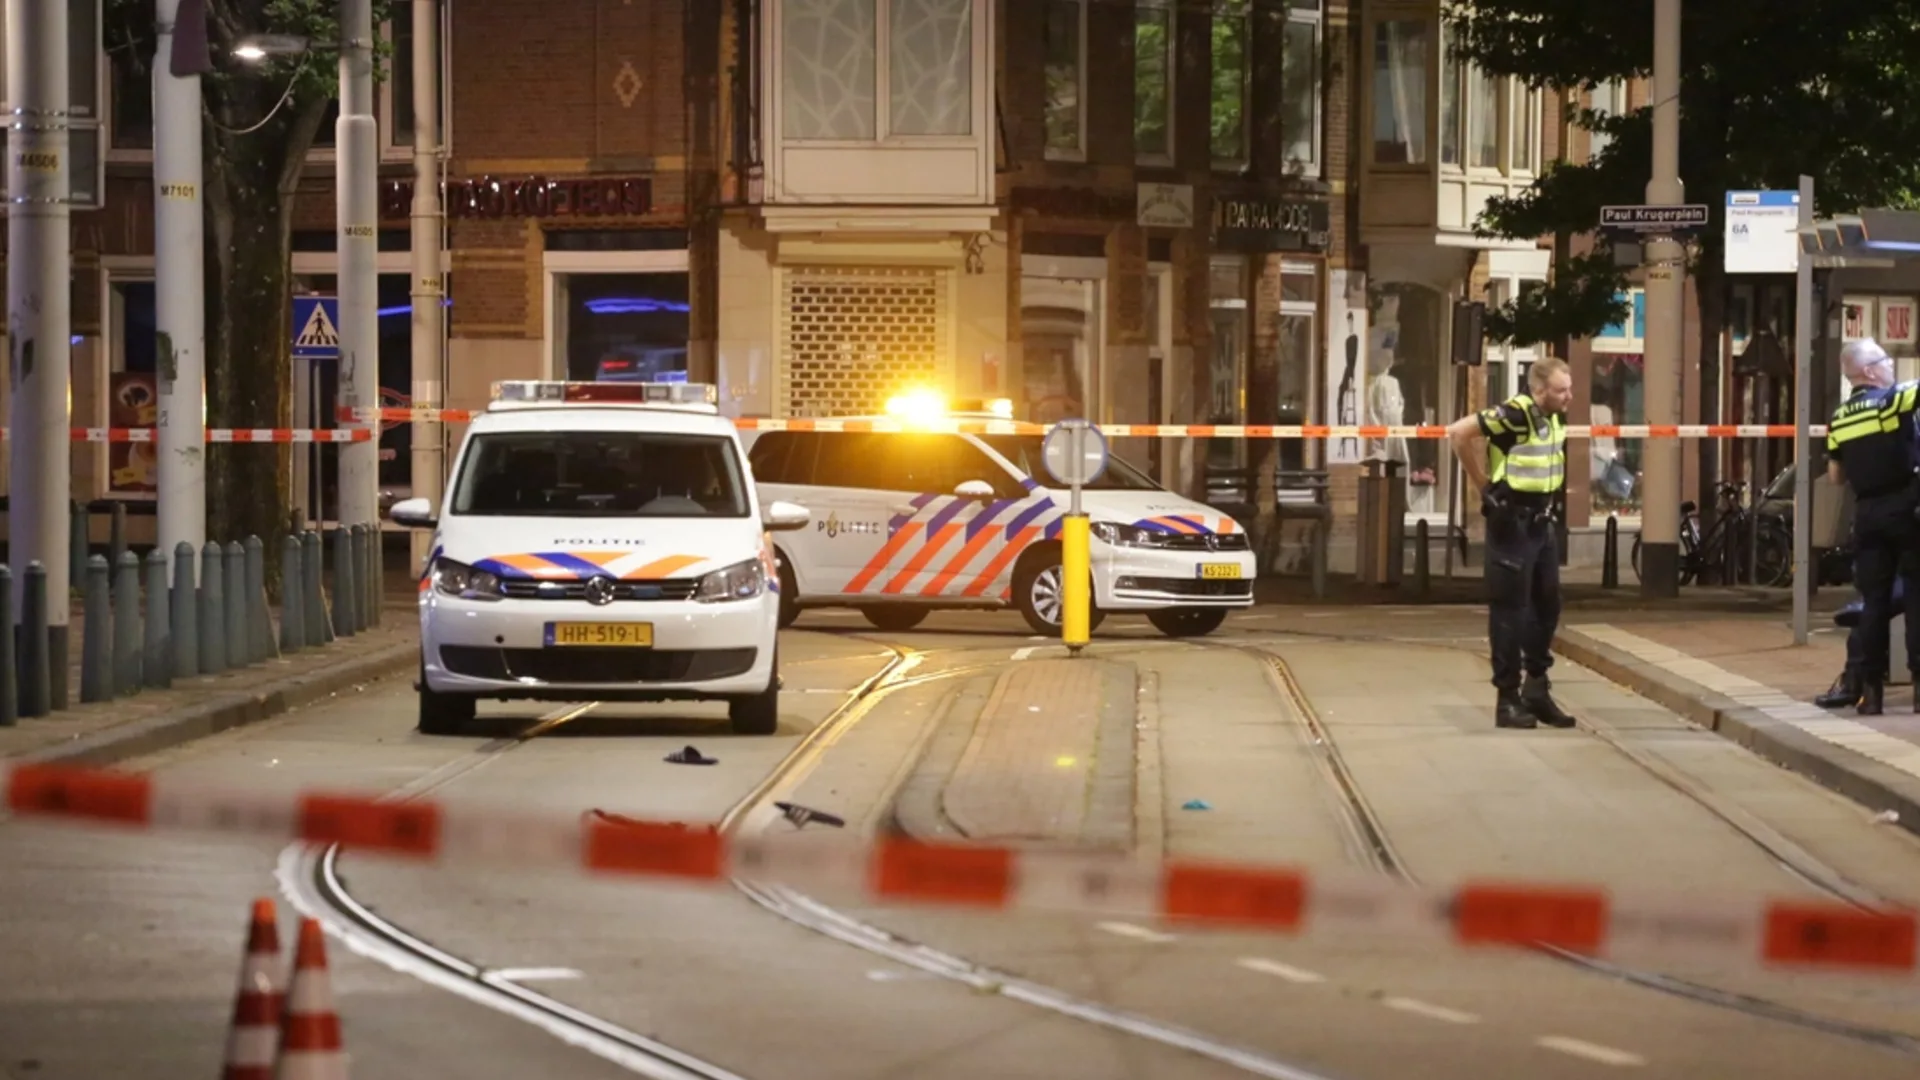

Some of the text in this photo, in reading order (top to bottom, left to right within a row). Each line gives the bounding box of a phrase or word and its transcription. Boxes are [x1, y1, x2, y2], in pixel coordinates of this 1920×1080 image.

[1605, 209, 1703, 223] Paul Krugerplein
[1732, 223, 1749, 234] 6A
[553, 538, 646, 546] POLITIE
[562, 625, 644, 642] HH-519-L
